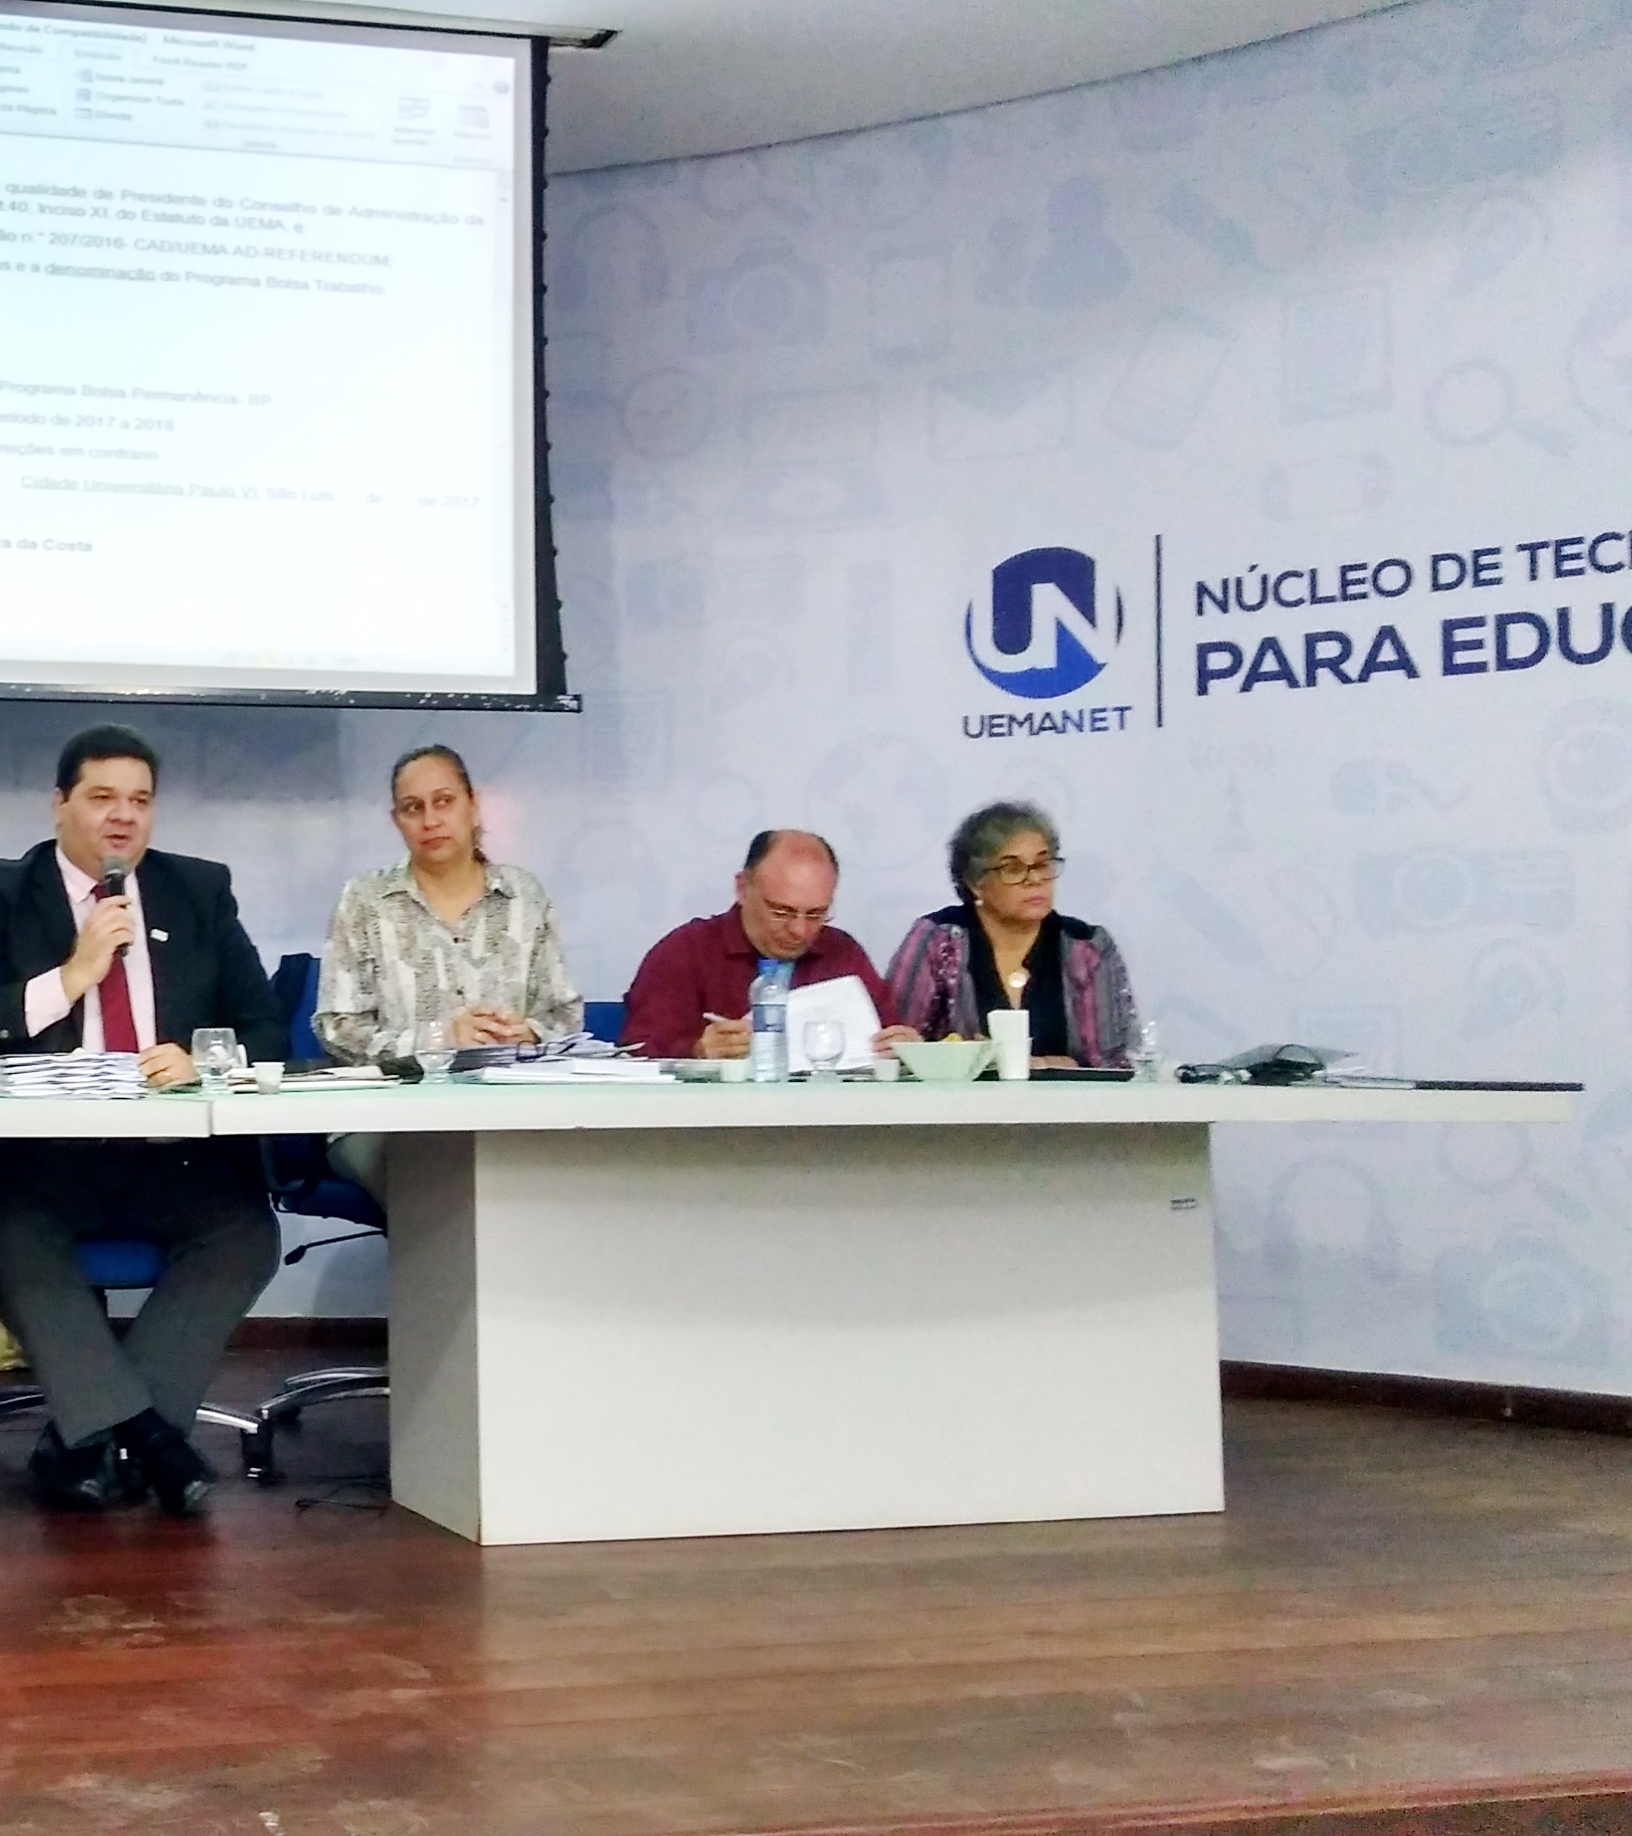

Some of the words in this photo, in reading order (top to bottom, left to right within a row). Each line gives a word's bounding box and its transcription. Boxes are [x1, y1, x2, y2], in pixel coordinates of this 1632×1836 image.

[45, 263, 156, 283] denominação
[160, 270, 181, 283] do
[1195, 558, 1413, 617] NÚCLEO
[1430, 547, 1503, 593] DE
[1515, 530, 1632, 582] TEC
[1195, 624, 1421, 696] PARA
[1441, 601, 1632, 677] EDU
[962, 705, 1133, 739] UEMANET
